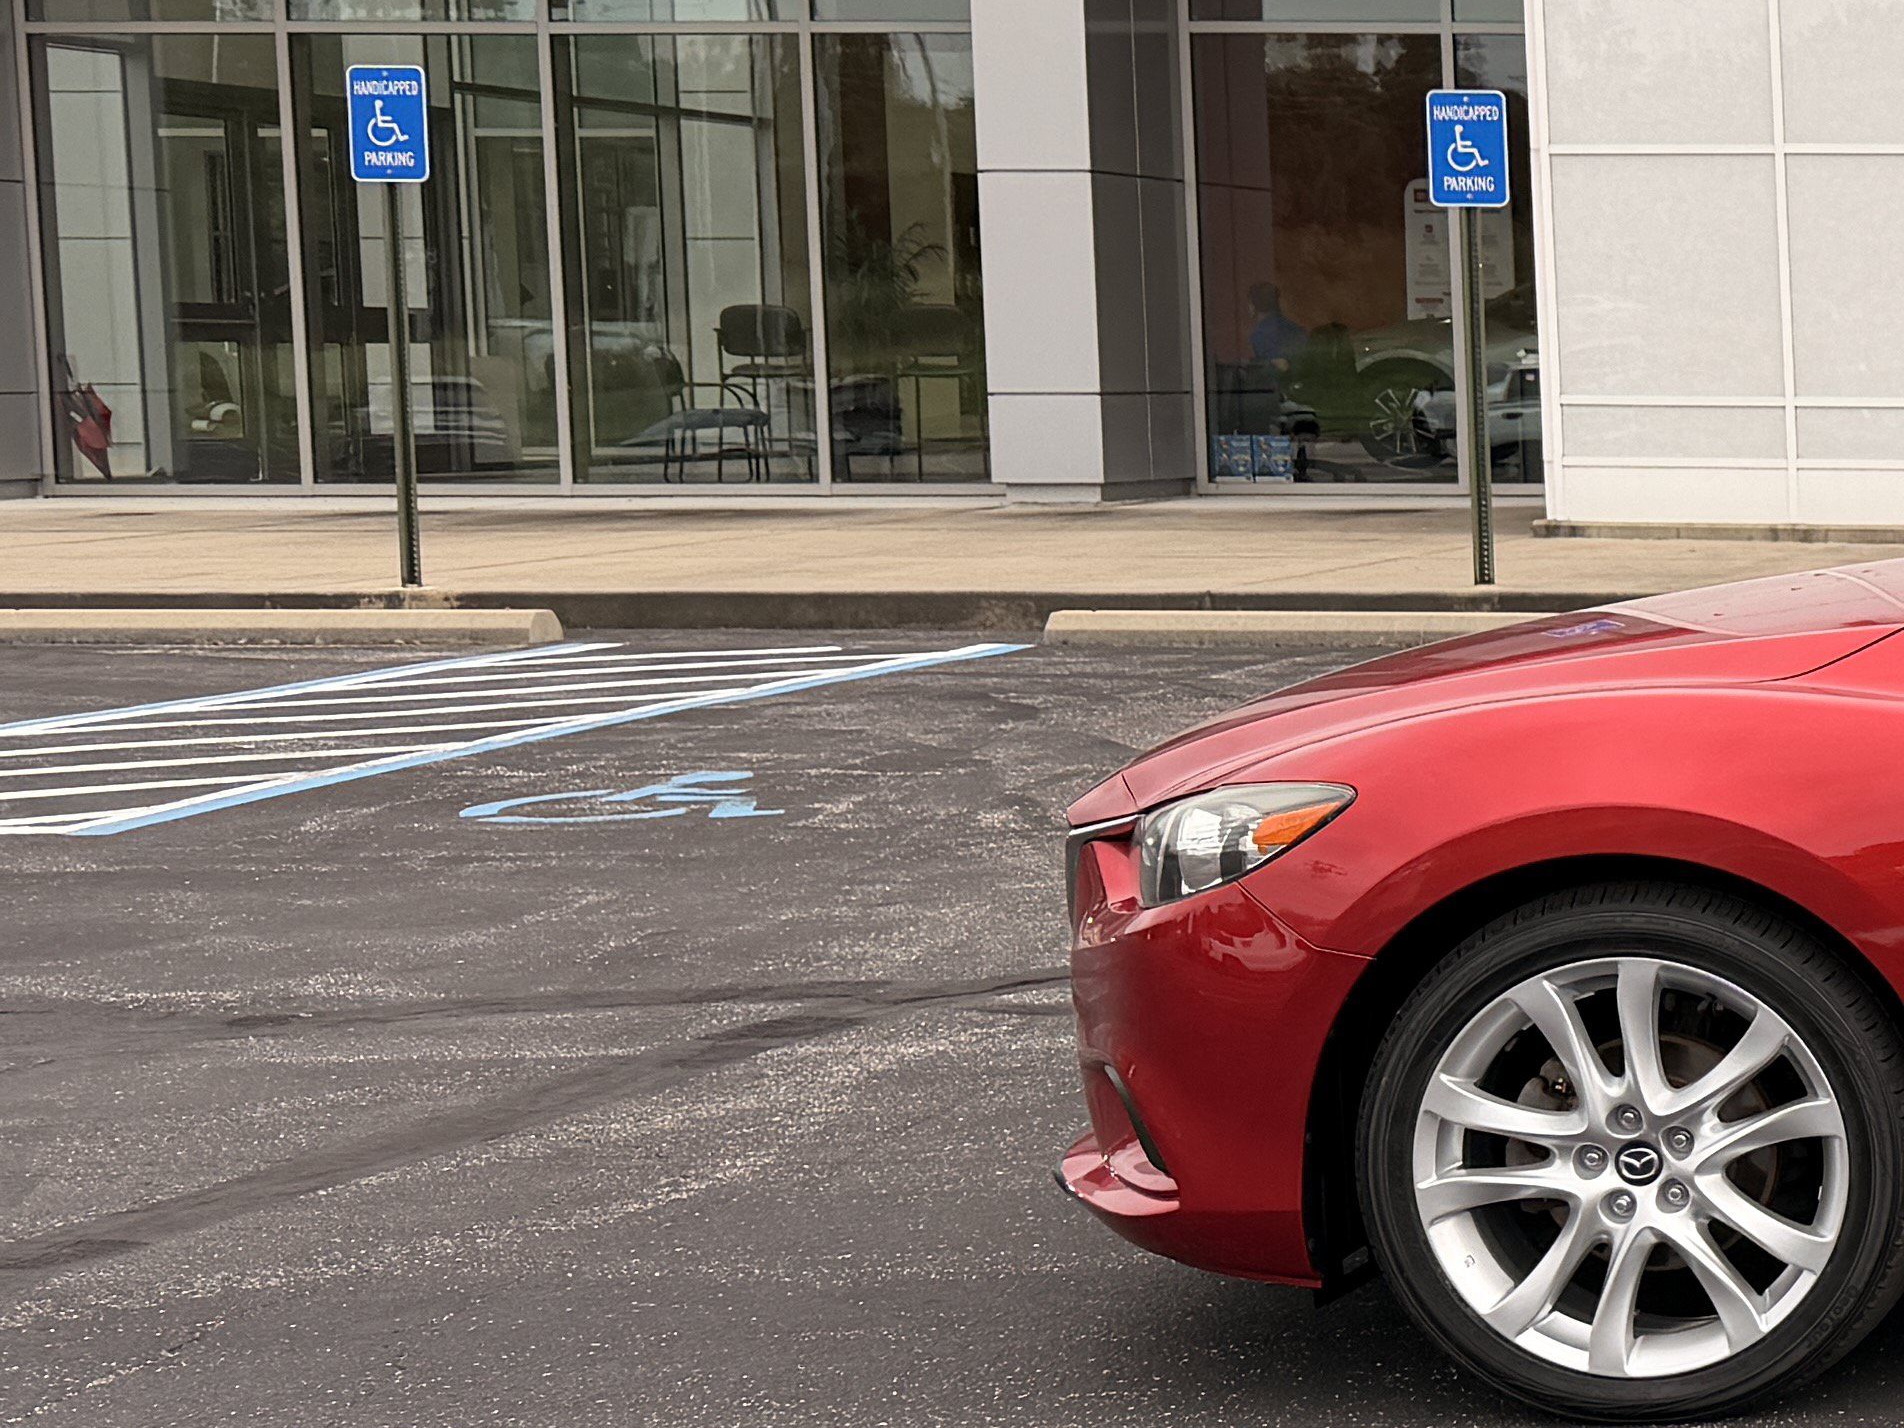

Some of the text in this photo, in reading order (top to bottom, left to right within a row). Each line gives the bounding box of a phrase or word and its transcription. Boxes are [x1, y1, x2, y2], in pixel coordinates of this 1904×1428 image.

[353, 80, 419, 95] HANDICAPPED
[1433, 105, 1499, 121] HANDICAPPED
[364, 151, 415, 167] PARKING
[1443, 175, 1495, 192] PARKING
